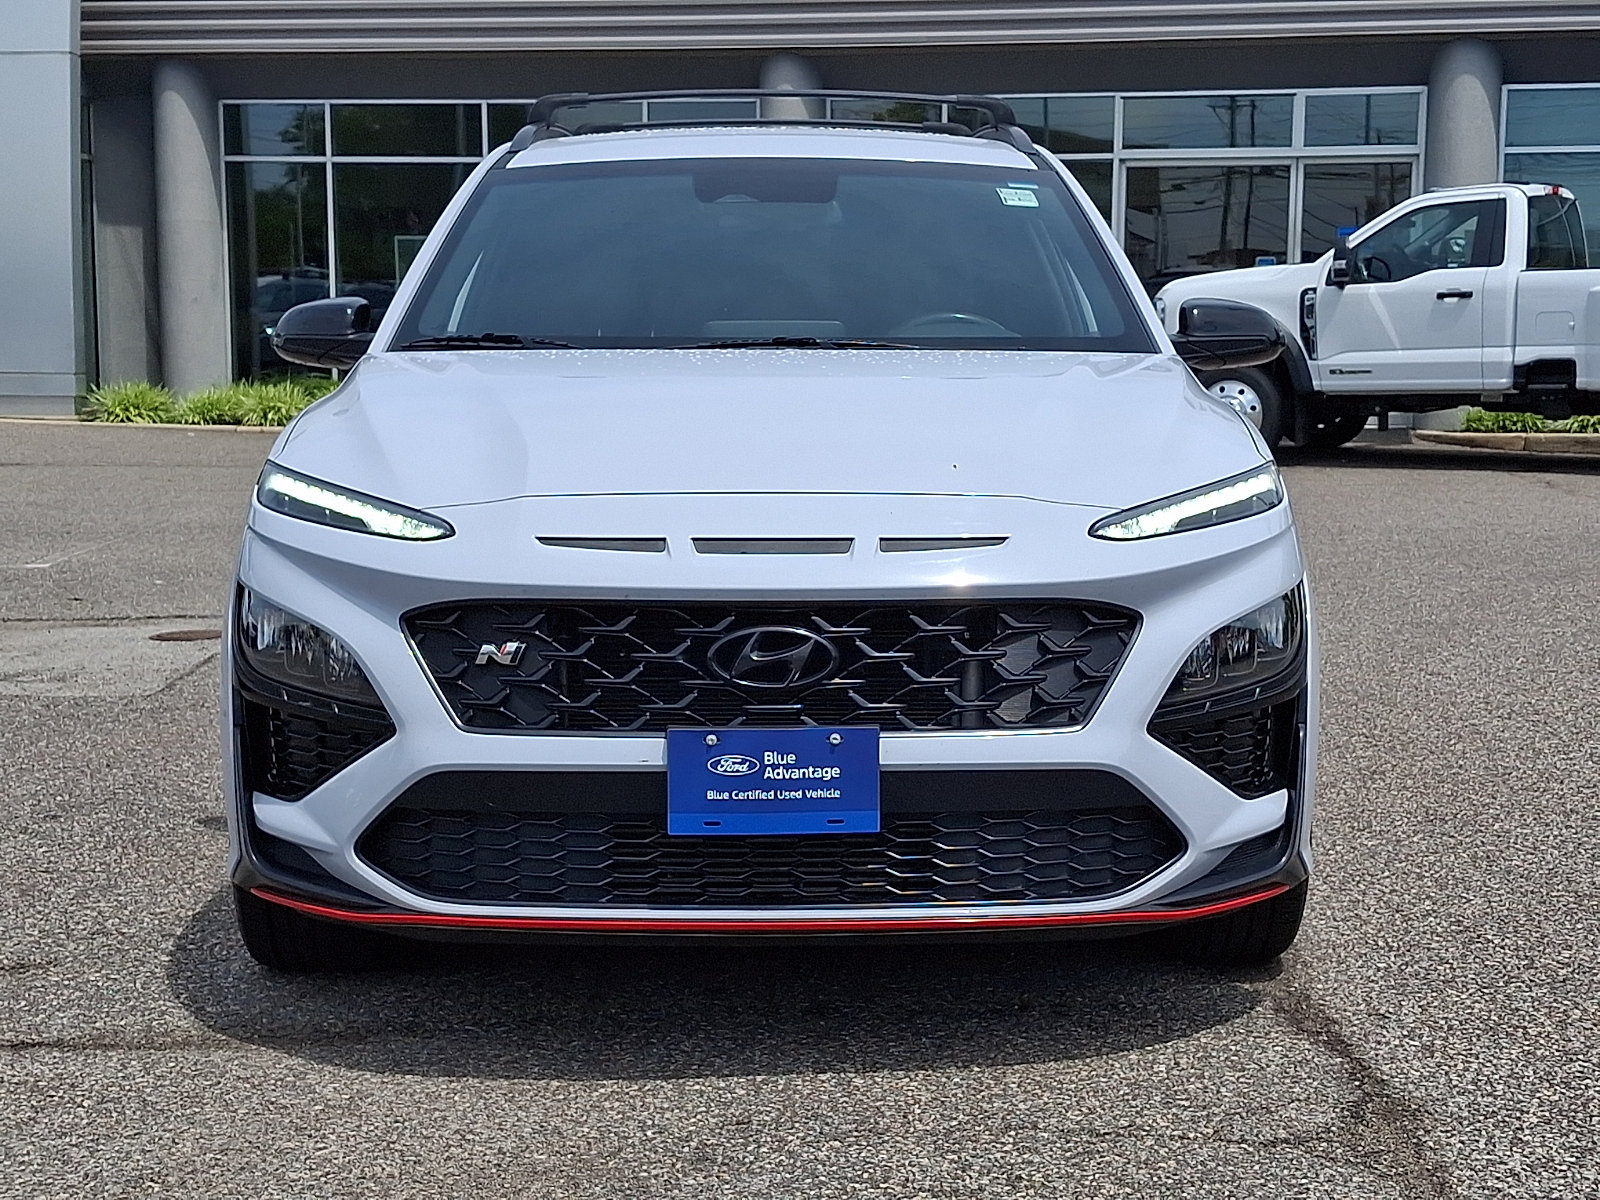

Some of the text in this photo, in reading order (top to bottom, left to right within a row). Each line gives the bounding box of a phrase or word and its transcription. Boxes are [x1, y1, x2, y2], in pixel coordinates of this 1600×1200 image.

[717, 758, 750, 772] Ford
[763, 751, 797, 765] Blue
[763, 766, 841, 781] Advantage
[706, 788, 841, 800] Blue Certified Used Vehicle
